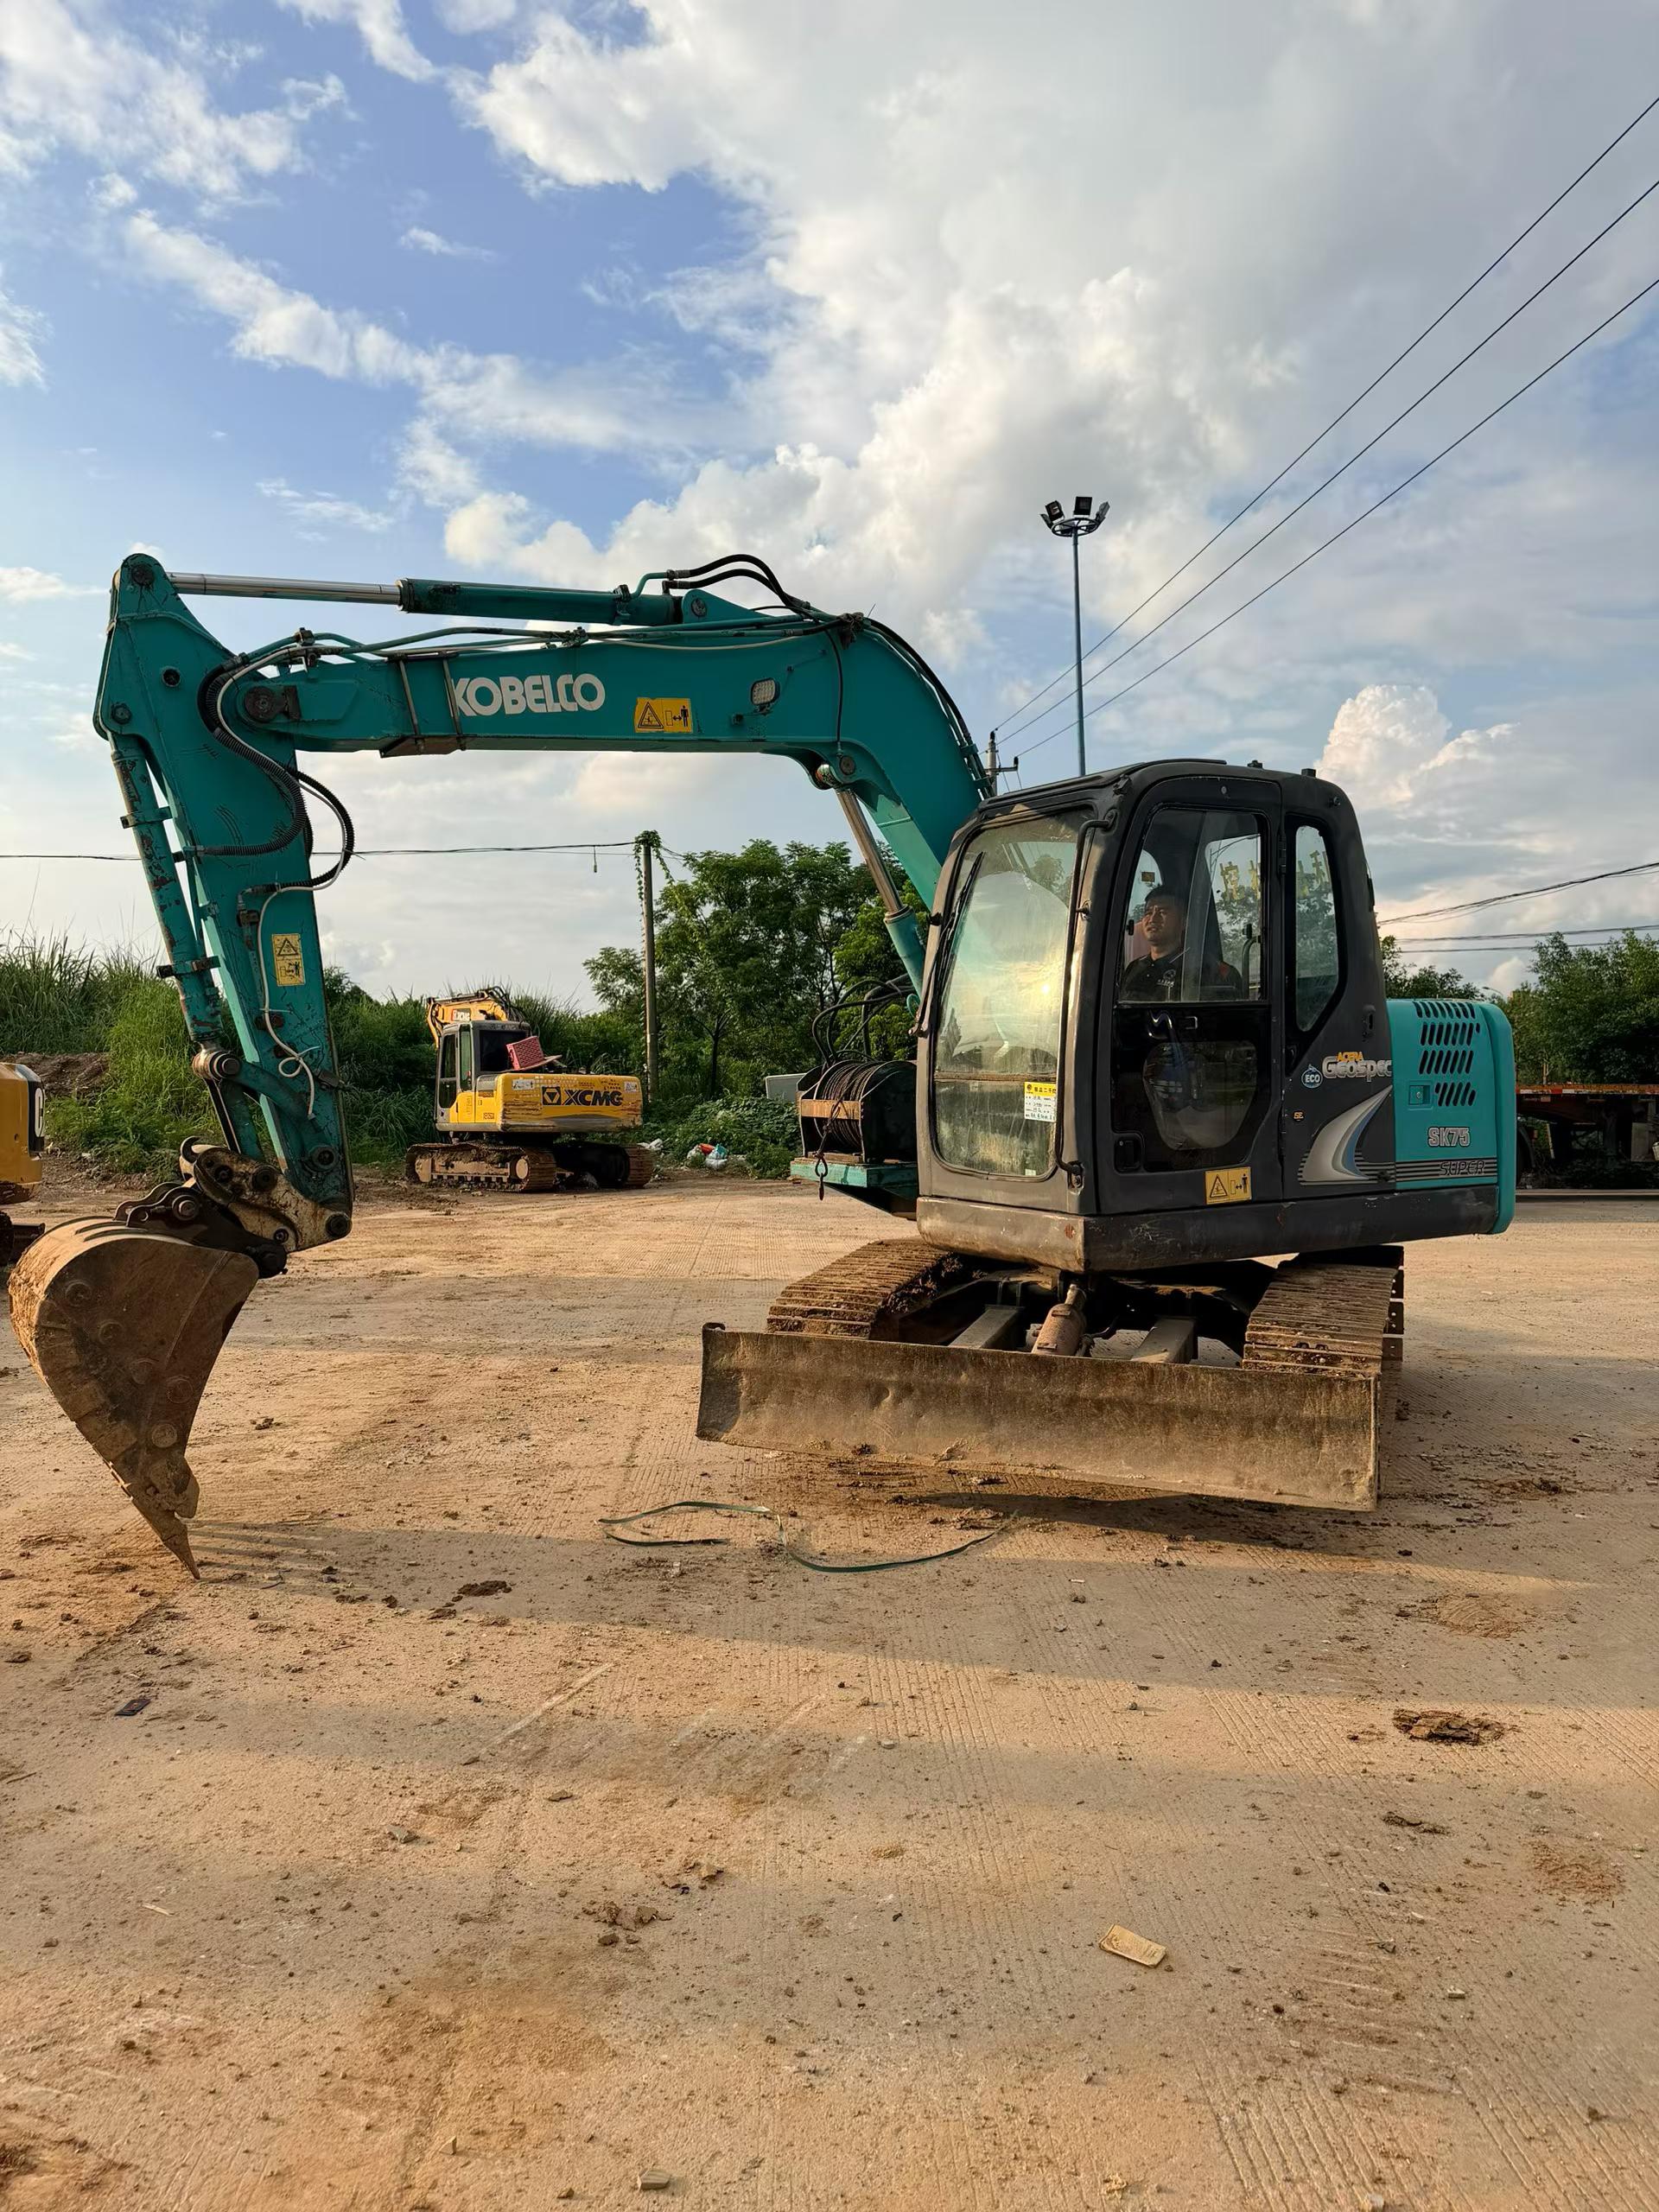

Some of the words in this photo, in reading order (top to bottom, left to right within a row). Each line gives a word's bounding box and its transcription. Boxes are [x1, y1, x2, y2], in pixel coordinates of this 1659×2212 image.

[445, 674, 605, 717] KOBELCO
[1305, 1074, 1321, 1084] ECO
[1322, 1056, 1393, 1083] Geospec
[562, 1089, 624, 1107] XCMG
[1428, 1127, 1471, 1147] SK75
